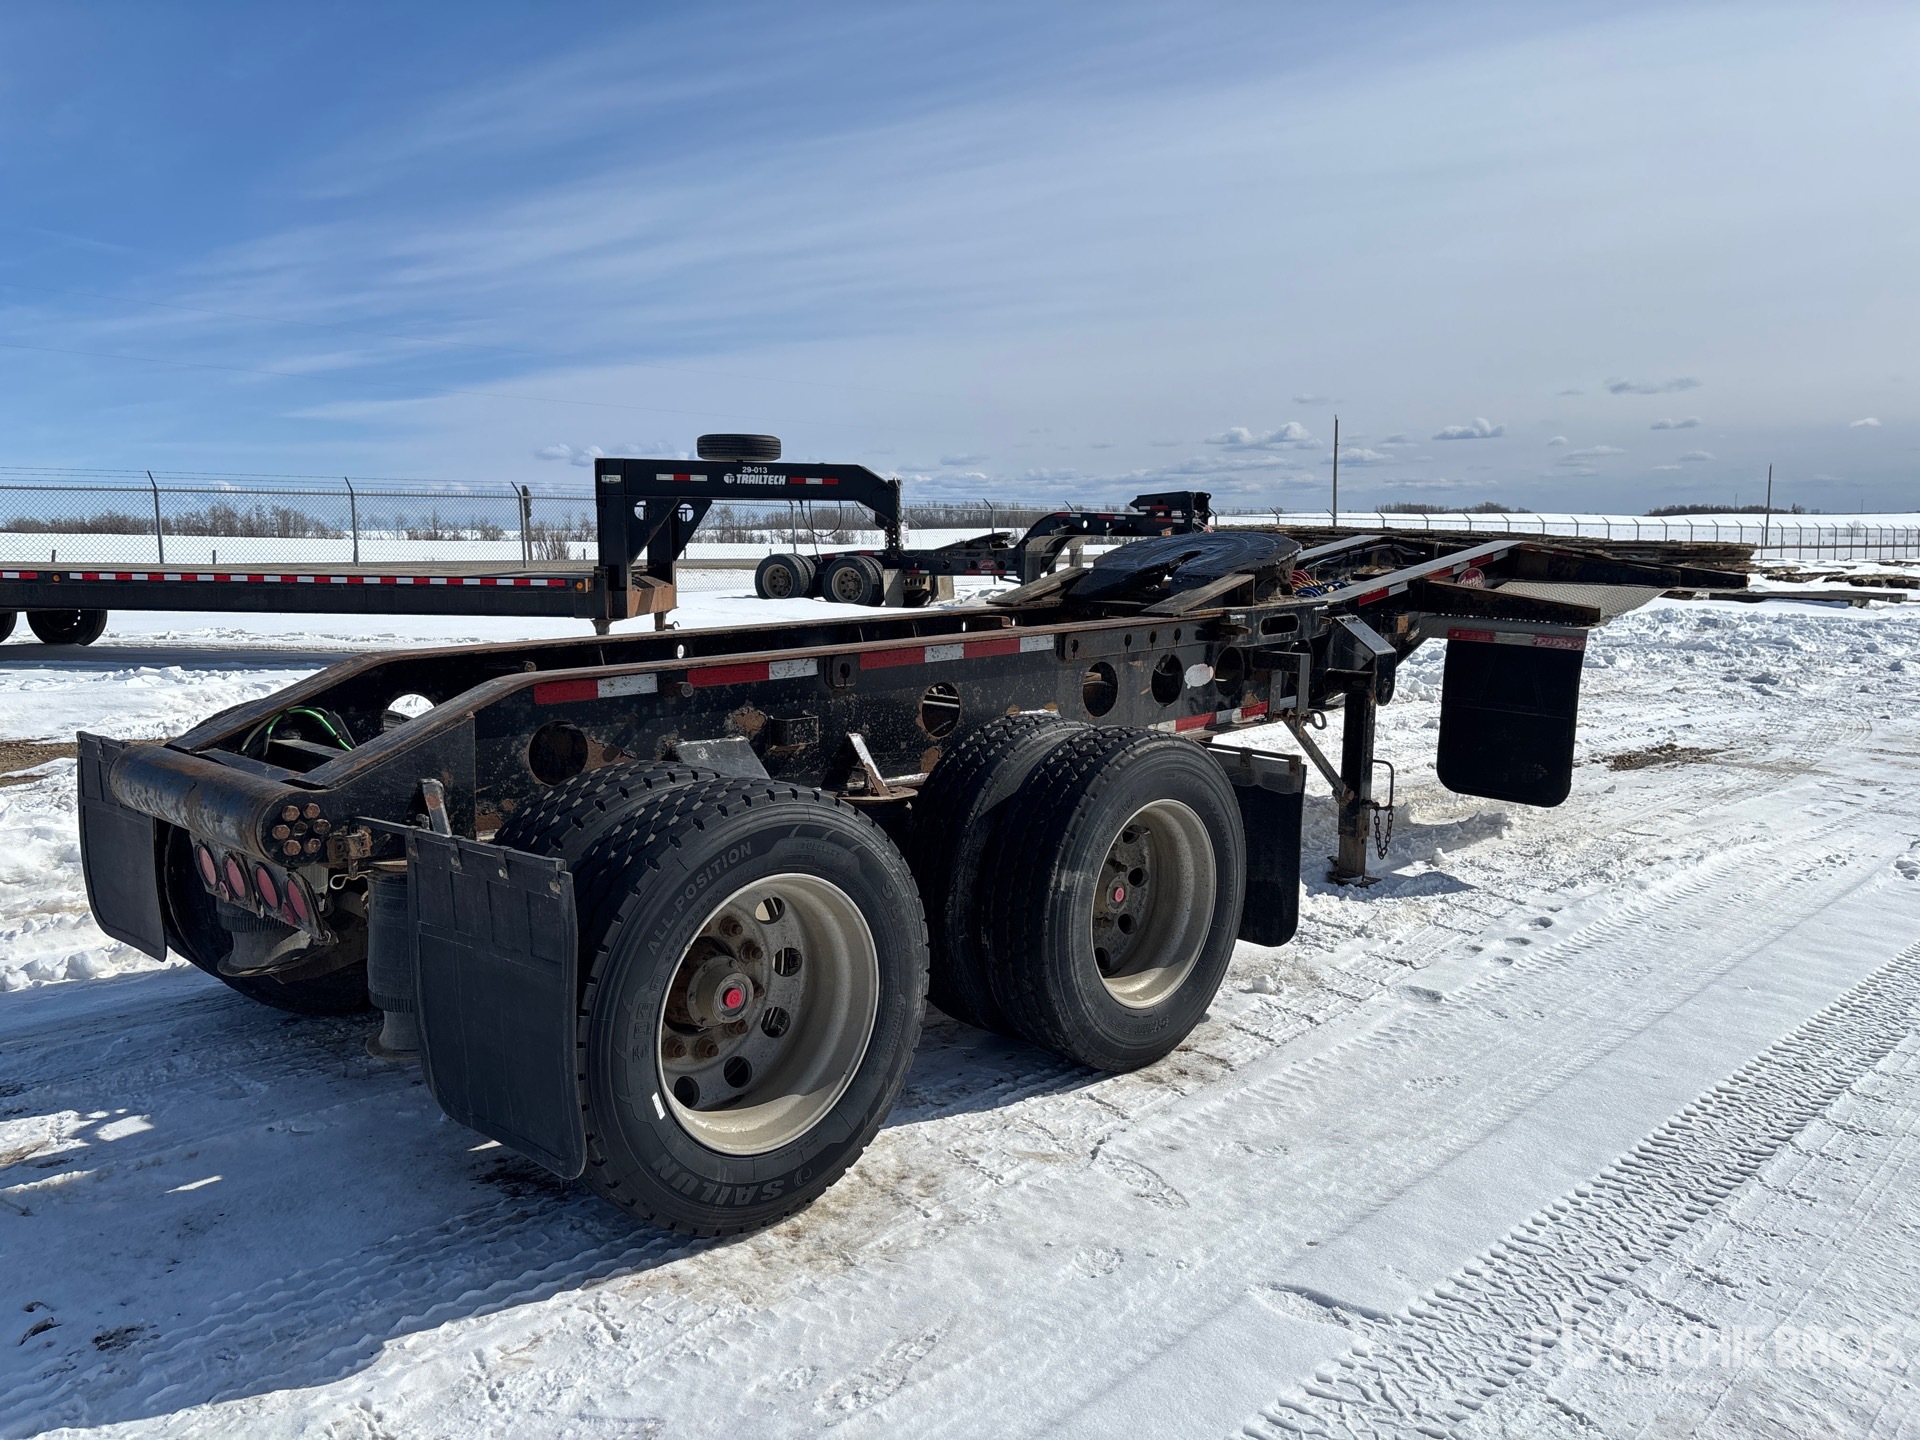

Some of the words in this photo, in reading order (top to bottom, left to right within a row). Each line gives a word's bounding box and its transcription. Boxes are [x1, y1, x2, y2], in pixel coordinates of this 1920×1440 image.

[736, 474, 786, 485] TRAILTECH
[647, 841, 752, 956] ALL-POSITION
[650, 1153, 784, 1205] SAILUN
